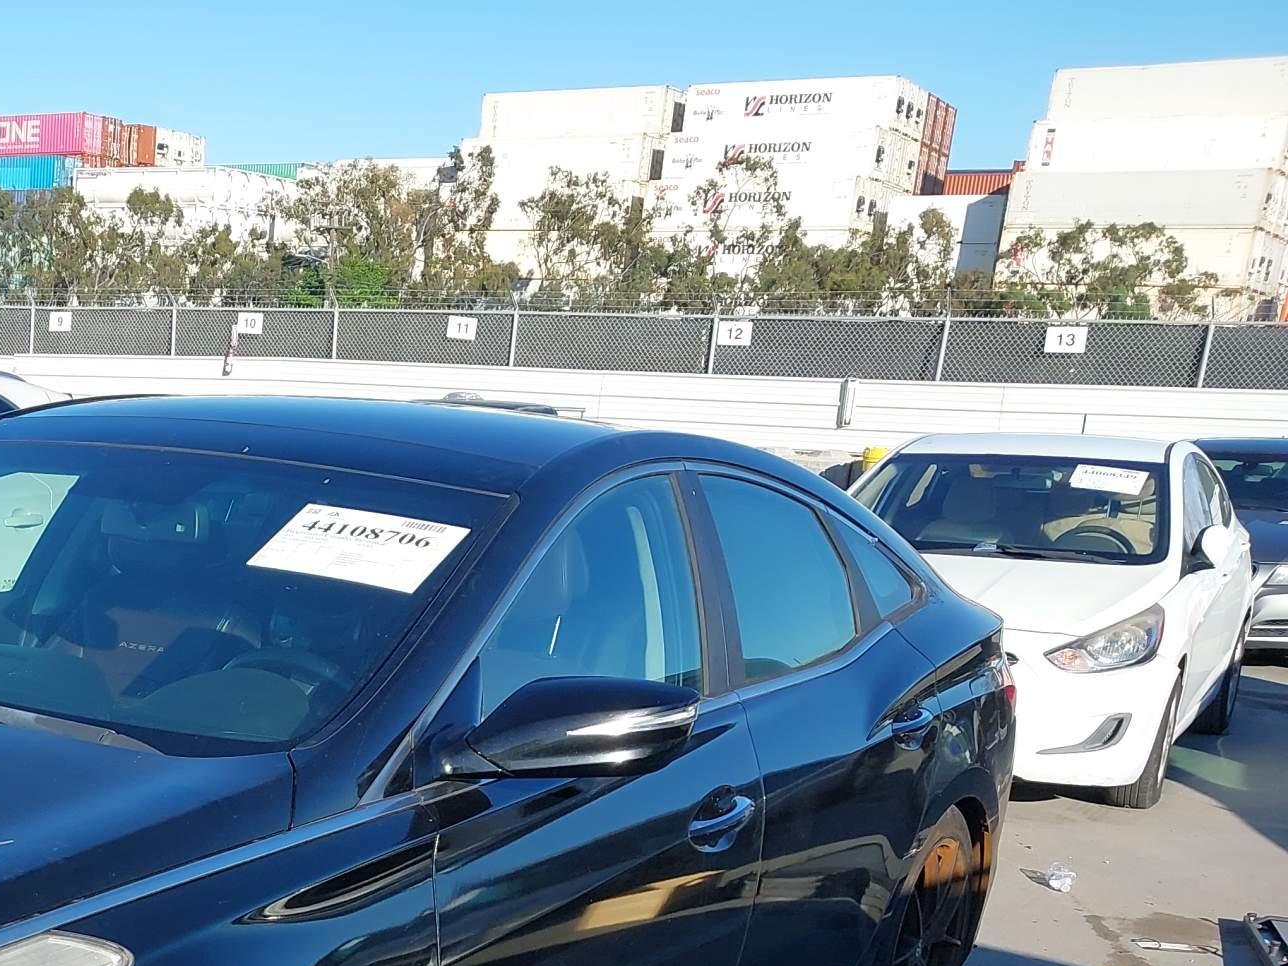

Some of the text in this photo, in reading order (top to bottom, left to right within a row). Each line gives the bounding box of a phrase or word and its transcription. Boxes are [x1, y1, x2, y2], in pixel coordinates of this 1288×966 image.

[769, 92, 832, 105] HORIZON
[748, 141, 812, 153] HORIZON
[728, 191, 792, 202] HORIZON
[57, 317, 63, 326] 9
[244, 319, 256, 329] 10
[456, 323, 469, 333] 11
[727, 328, 744, 340] 12
[1056, 333, 1076, 347] 13
[302, 519, 433, 548] 44108706
